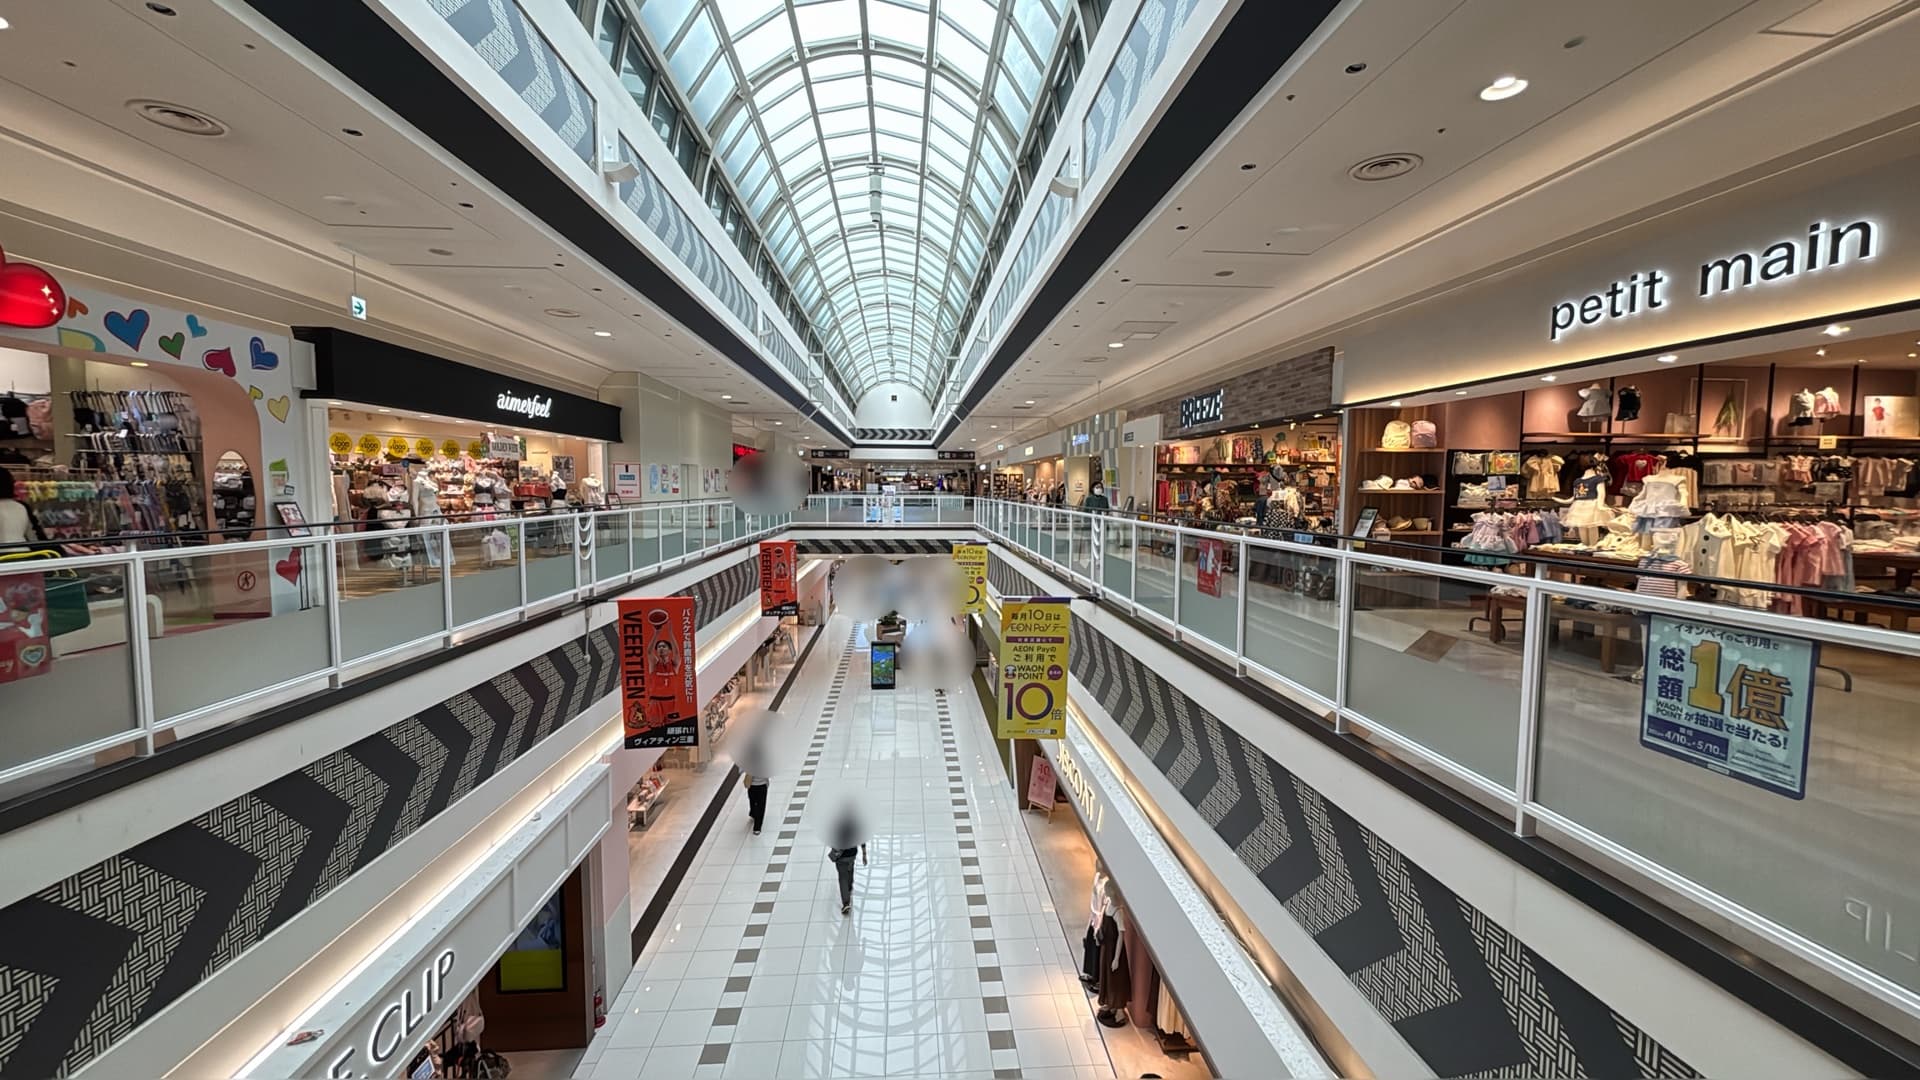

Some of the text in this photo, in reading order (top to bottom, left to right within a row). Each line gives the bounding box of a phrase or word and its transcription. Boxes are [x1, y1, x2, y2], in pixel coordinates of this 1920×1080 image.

[1550, 221, 1875, 341] petit main
[496, 389, 552, 419] aimerfeel
[1179, 389, 1223, 429] BREEZE
[623, 610, 646, 700] VEERTIEN
[1017, 664, 1045, 673] WAON
[1017, 672, 1045, 680] POINT
[1657, 645, 1686, 702] 総額
[1656, 699, 1684, 713] WAON
[1656, 707, 1683, 720] POINT
